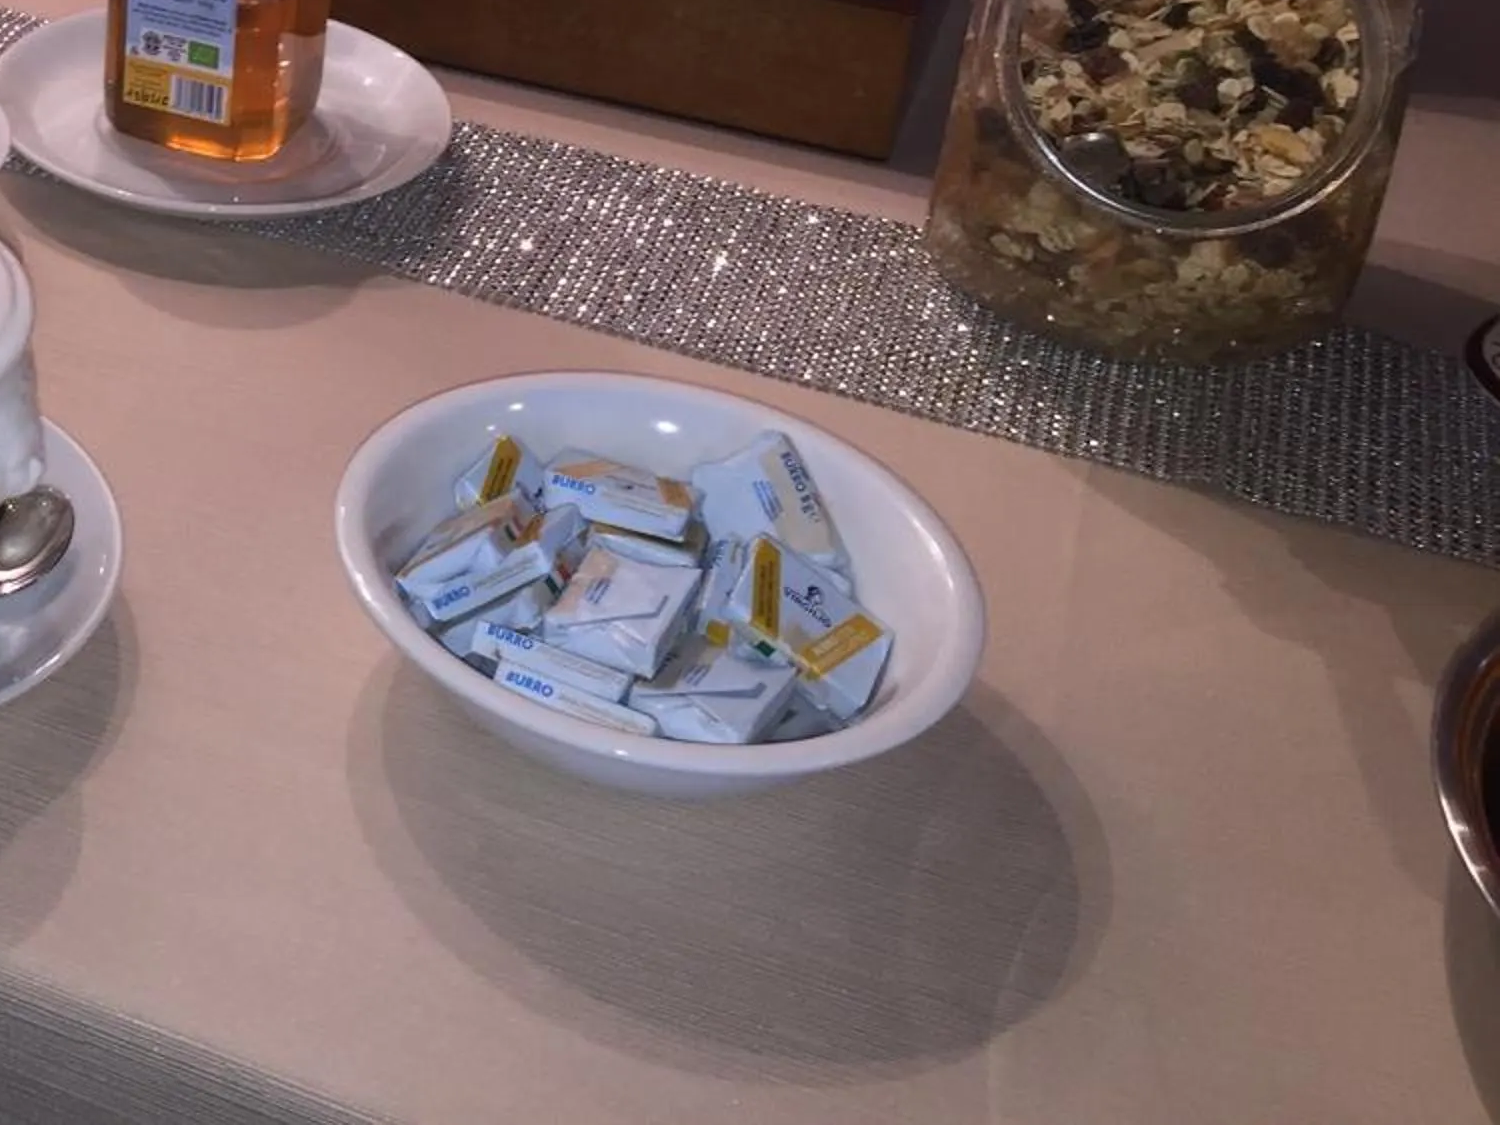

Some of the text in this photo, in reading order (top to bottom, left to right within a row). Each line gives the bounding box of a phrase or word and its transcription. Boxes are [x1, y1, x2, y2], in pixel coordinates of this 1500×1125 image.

[551, 474, 597, 497] BURRO
[431, 585, 472, 610] BURRO
[486, 623, 535, 651] BURRO
[505, 670, 555, 699] BURRO
